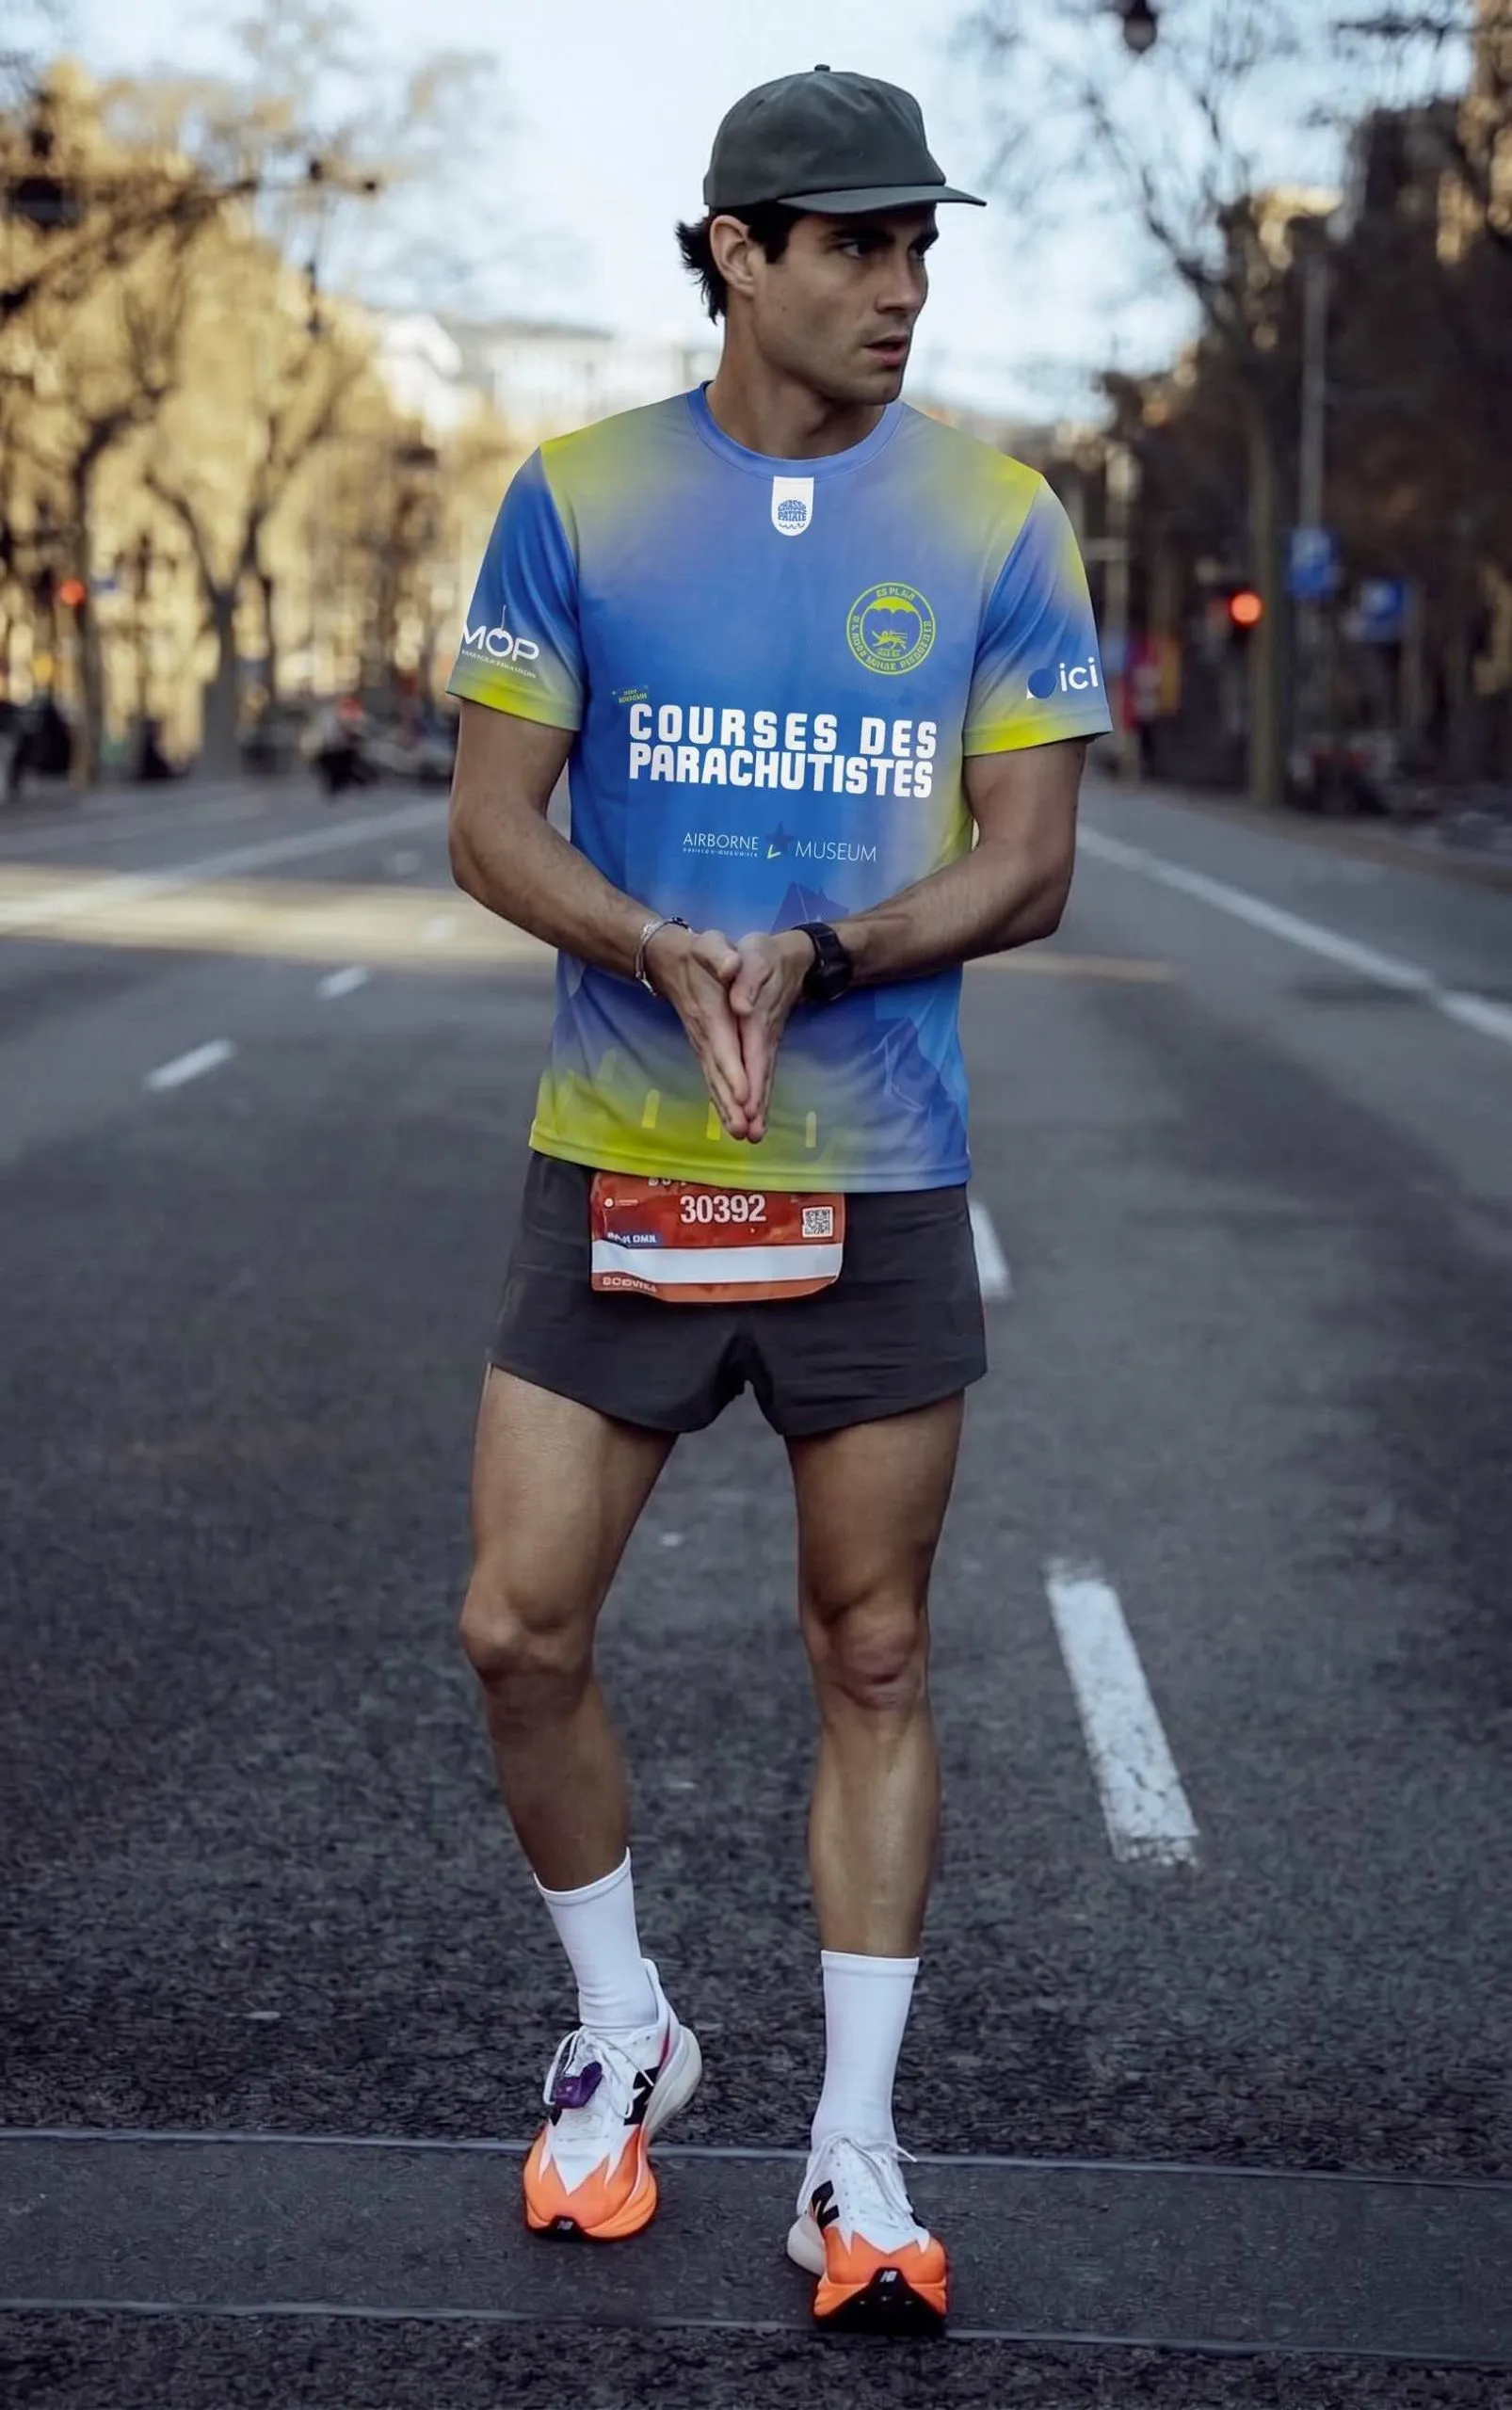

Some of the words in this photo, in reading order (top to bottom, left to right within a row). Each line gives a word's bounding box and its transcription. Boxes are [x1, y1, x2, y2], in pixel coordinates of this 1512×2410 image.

[1059, 656, 1099, 692] ici
[629, 703, 837, 752] COURSES
[859, 716, 937, 759] DES
[629, 742, 933, 798] PARACHUTISTES
[683, 832, 759, 850] AIRBORNE
[795, 840, 877, 862] MUSEUM
[680, 1194, 767, 1223] 30392
